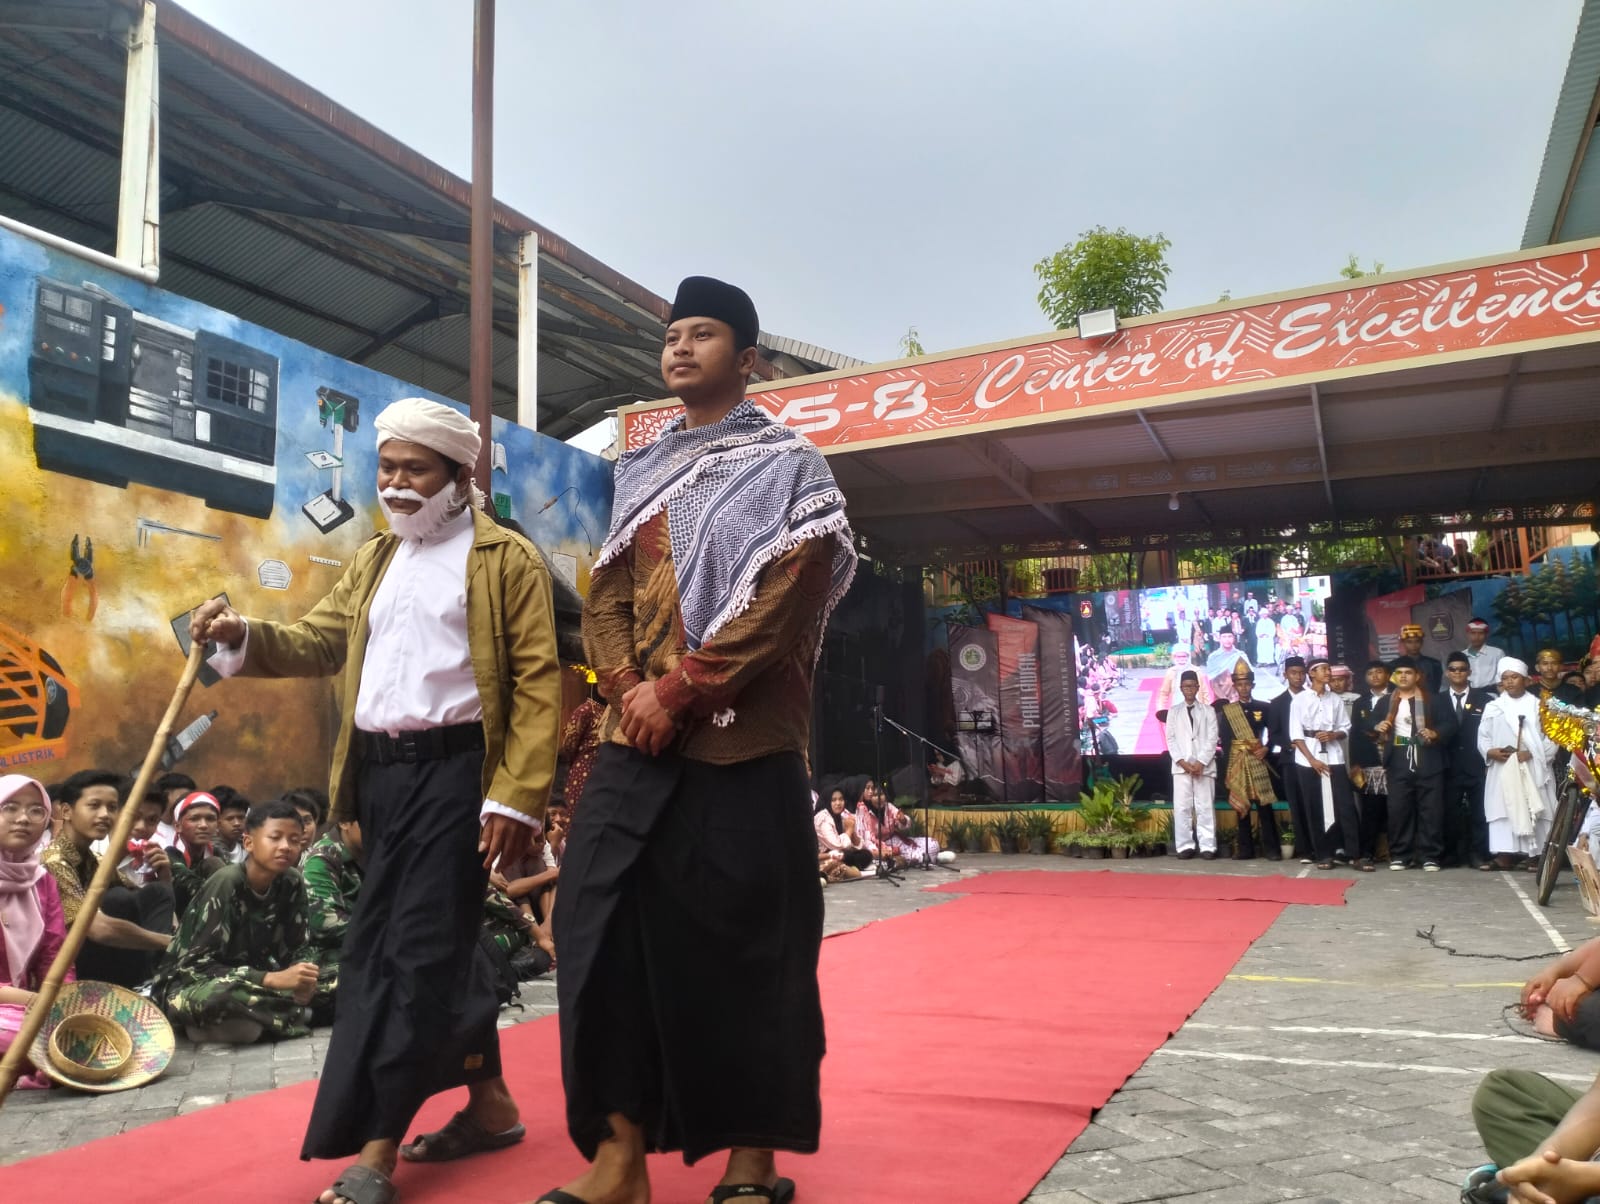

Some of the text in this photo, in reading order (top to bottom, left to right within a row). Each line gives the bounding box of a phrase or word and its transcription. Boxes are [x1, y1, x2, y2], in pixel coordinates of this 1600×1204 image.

[974, 350, 1161, 409] Center
[1184, 321, 1245, 381] of
[1018, 652, 1040, 728] PAHLAWAN
[1061, 667, 1072, 723] NOVEMBER
[12, 748, 55, 765] LISTRIK
